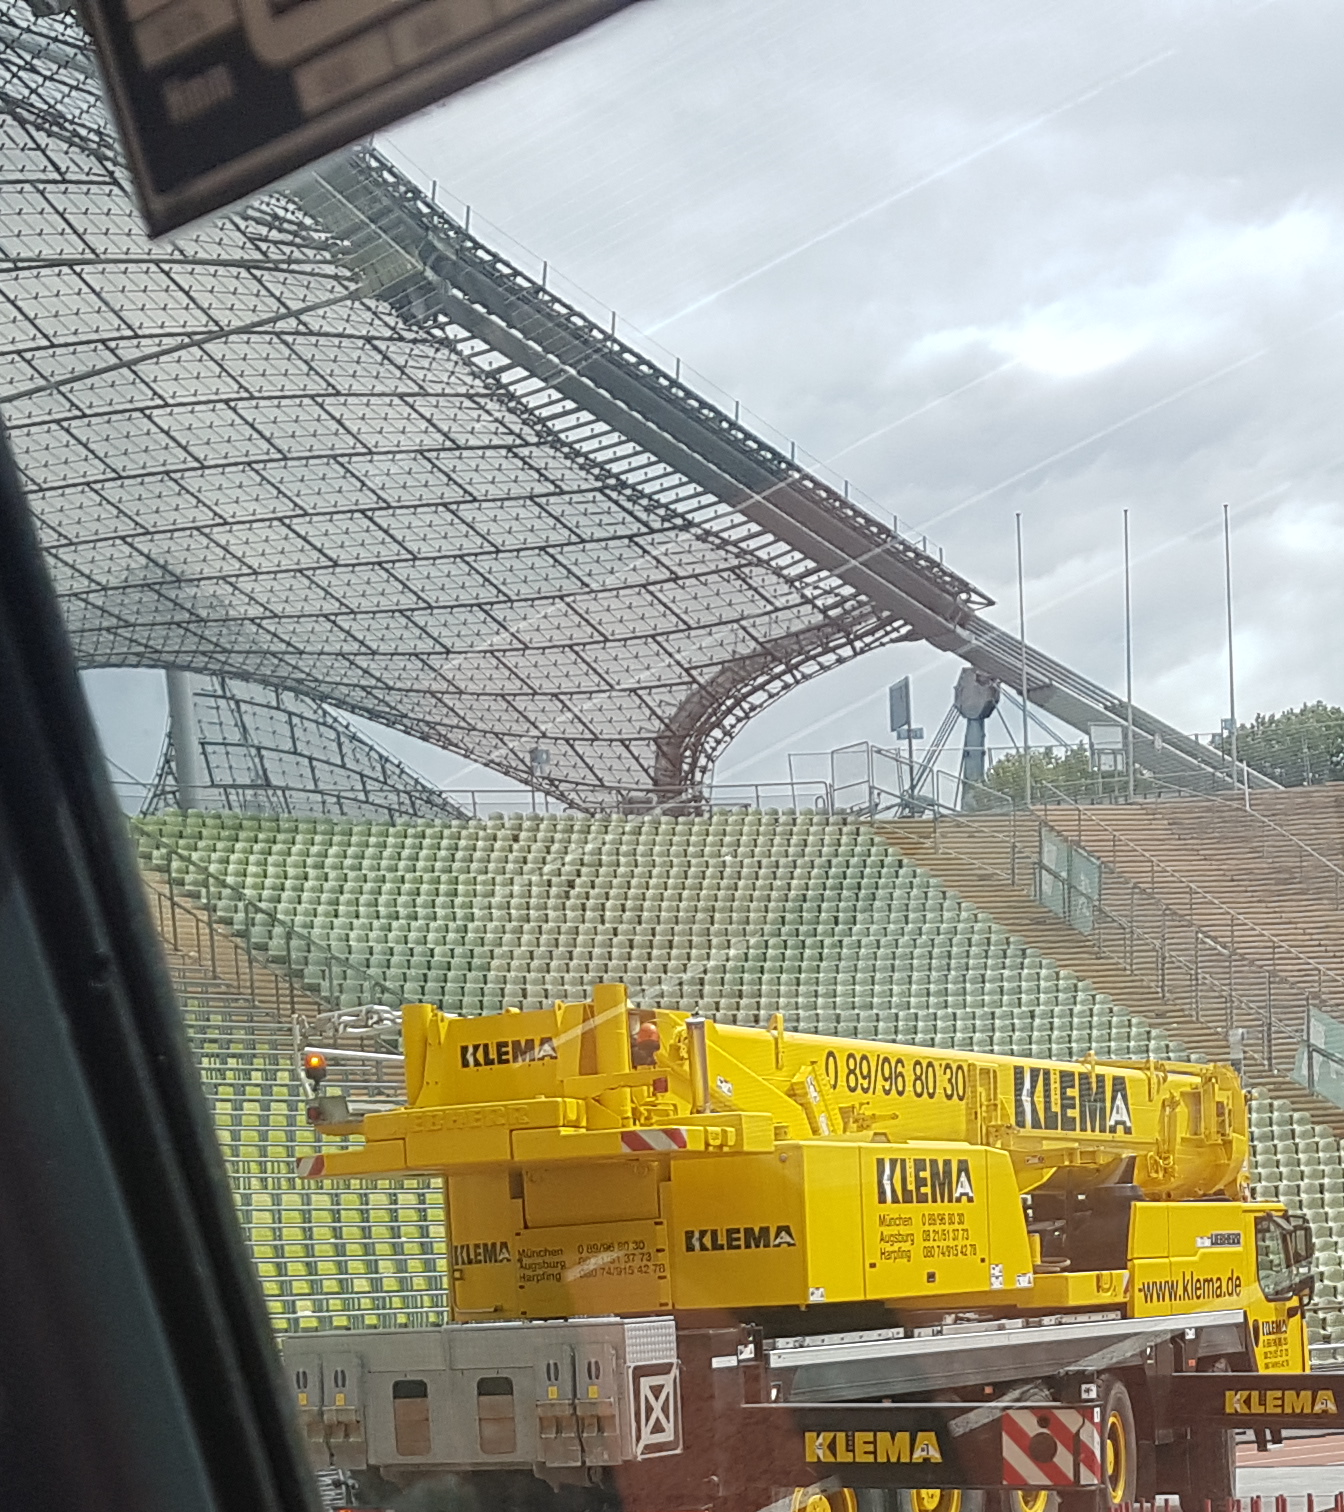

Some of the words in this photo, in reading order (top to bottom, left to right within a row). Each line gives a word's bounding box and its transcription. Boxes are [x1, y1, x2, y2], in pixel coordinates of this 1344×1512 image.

[460, 1037, 558, 1068] KLEMA
[825, 1050, 838, 1091] 0
[846, 1052, 906, 1097] 89/96
[913, 1059, 937, 1099] 80
[943, 1062, 966, 1101] 30
[1013, 1065, 1133, 1135] KLEMA
[876, 1158, 974, 1204] KLEMA
[878, 1214, 913, 1227] München
[517, 1248, 564, 1261] München
[631, 1240, 645, 1250] 30
[684, 1225, 796, 1252] KLEMA
[879, 1230, 914, 1246] Augsburg
[453, 1241, 511, 1266] KLEMA
[518, 1258, 566, 1272] Augsburg
[879, 1247, 911, 1262] Harpfing
[518, 1272, 562, 1284] Harpfing
[637, 1264, 650, 1274] 42
[1142, 1268, 1242, 1304] www.klema.de
[1225, 1390, 1338, 1414] KLEMA
[805, 1431, 943, 1463] KLEMA
